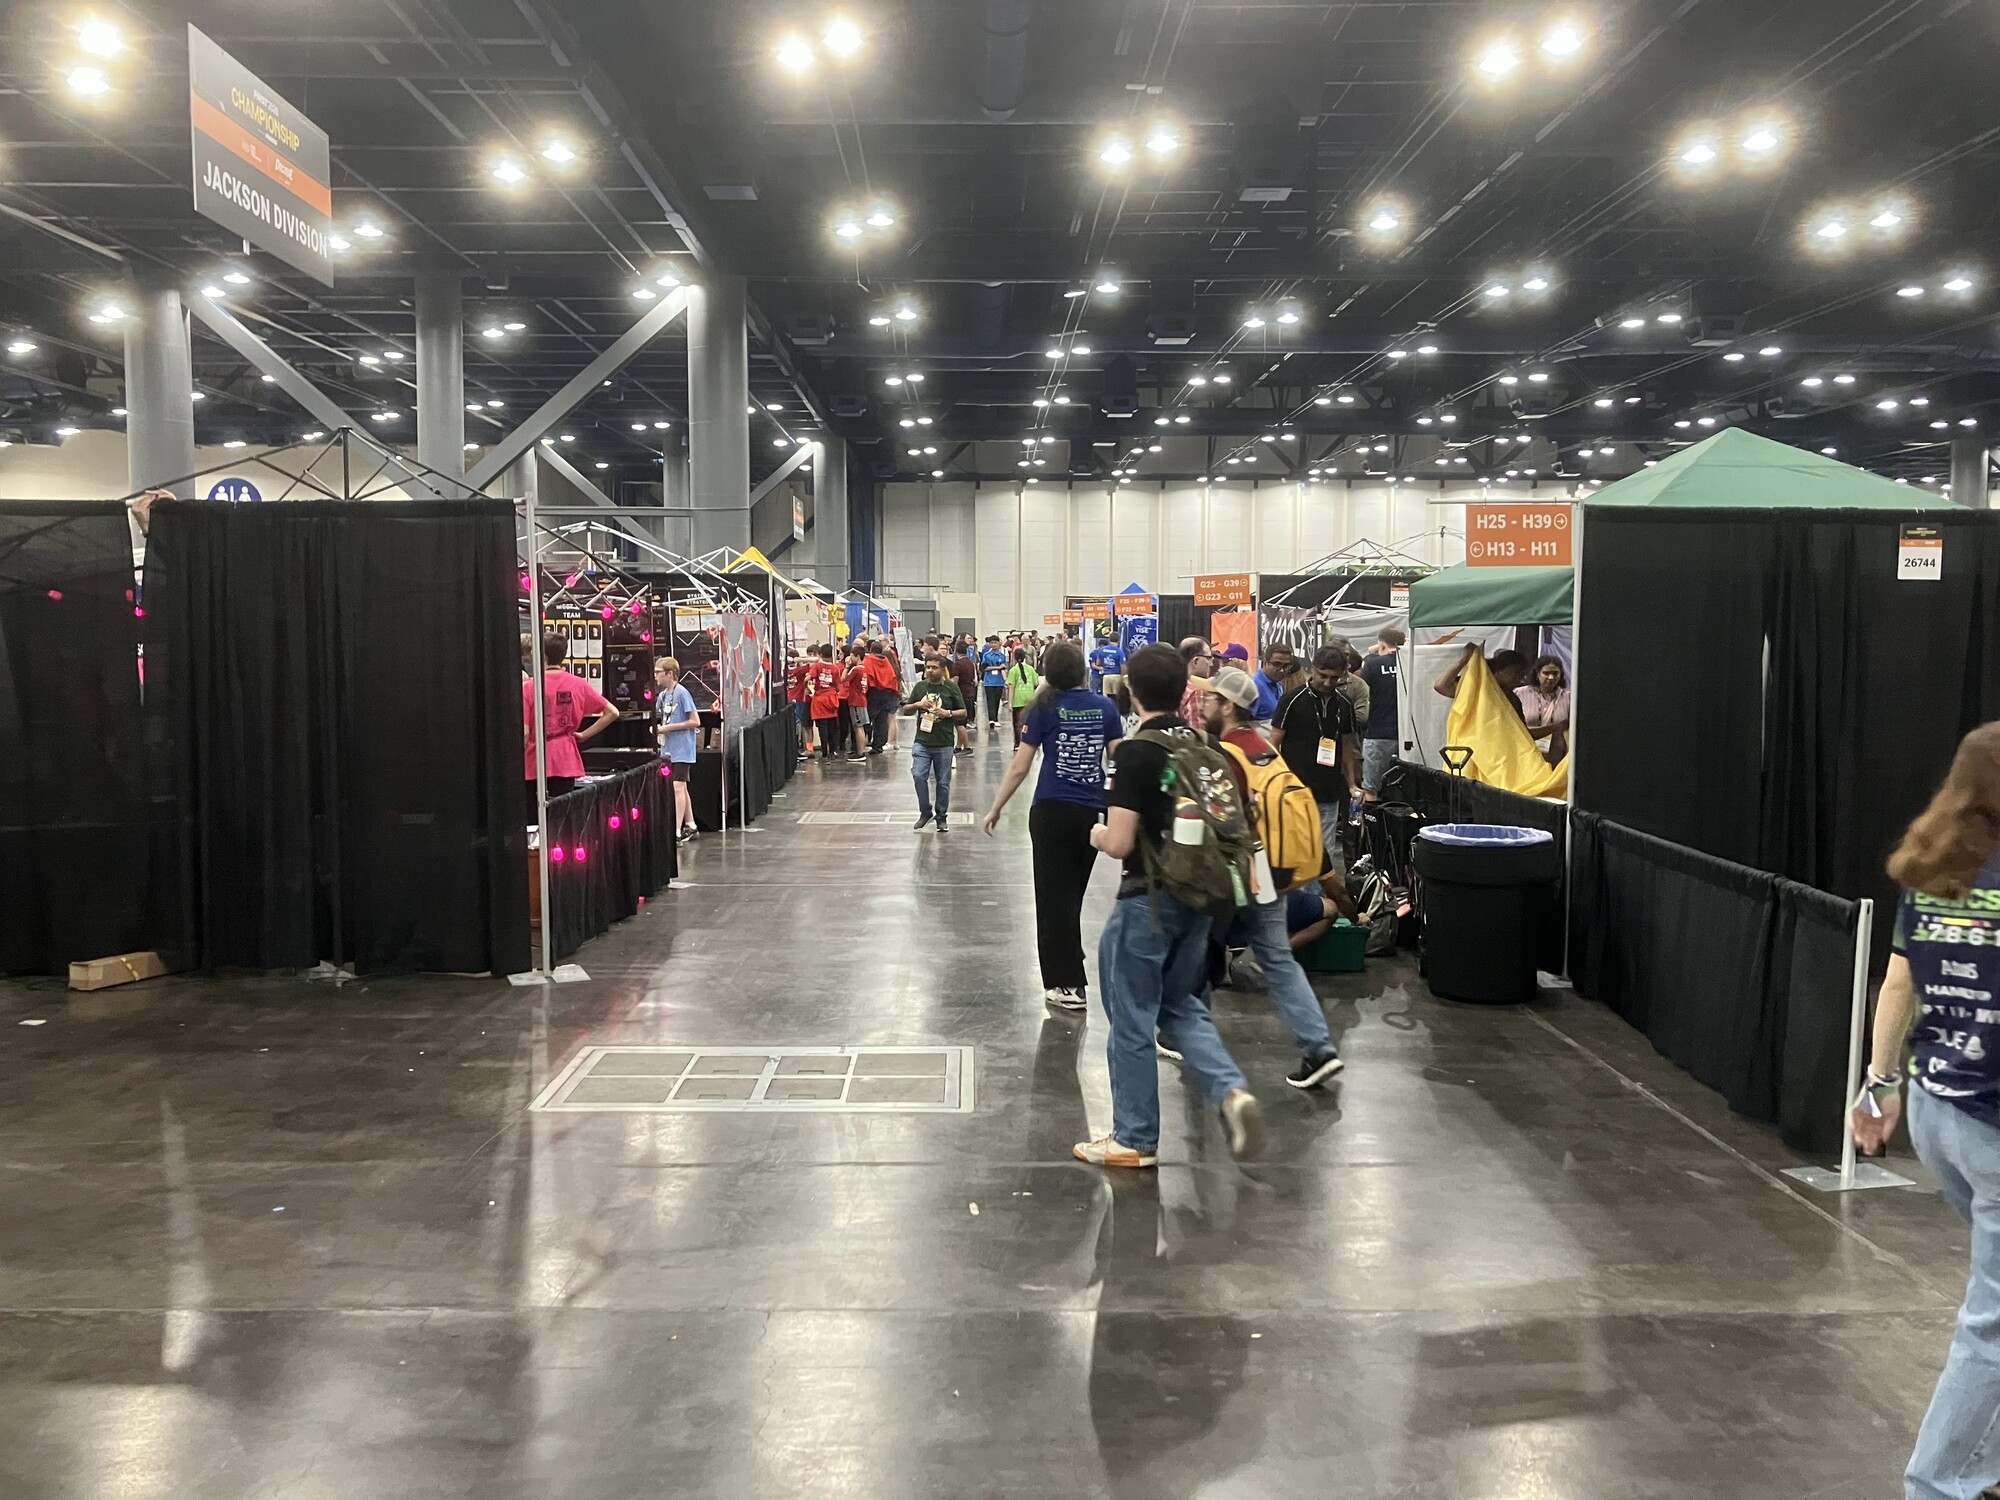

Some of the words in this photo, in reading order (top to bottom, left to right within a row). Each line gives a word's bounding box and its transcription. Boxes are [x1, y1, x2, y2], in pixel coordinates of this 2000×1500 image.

[231, 87, 300, 152] CHAMPIONSHIP
[203, 160, 271, 224] JACKSON
[273, 203, 328, 259] DIVISION
[1476, 514, 1506, 529] H25
[1522, 514, 1552, 529] H39
[1487, 541, 1515, 556] H13
[1531, 541, 1557, 556] H11
[1904, 558, 1936, 568] 26744
